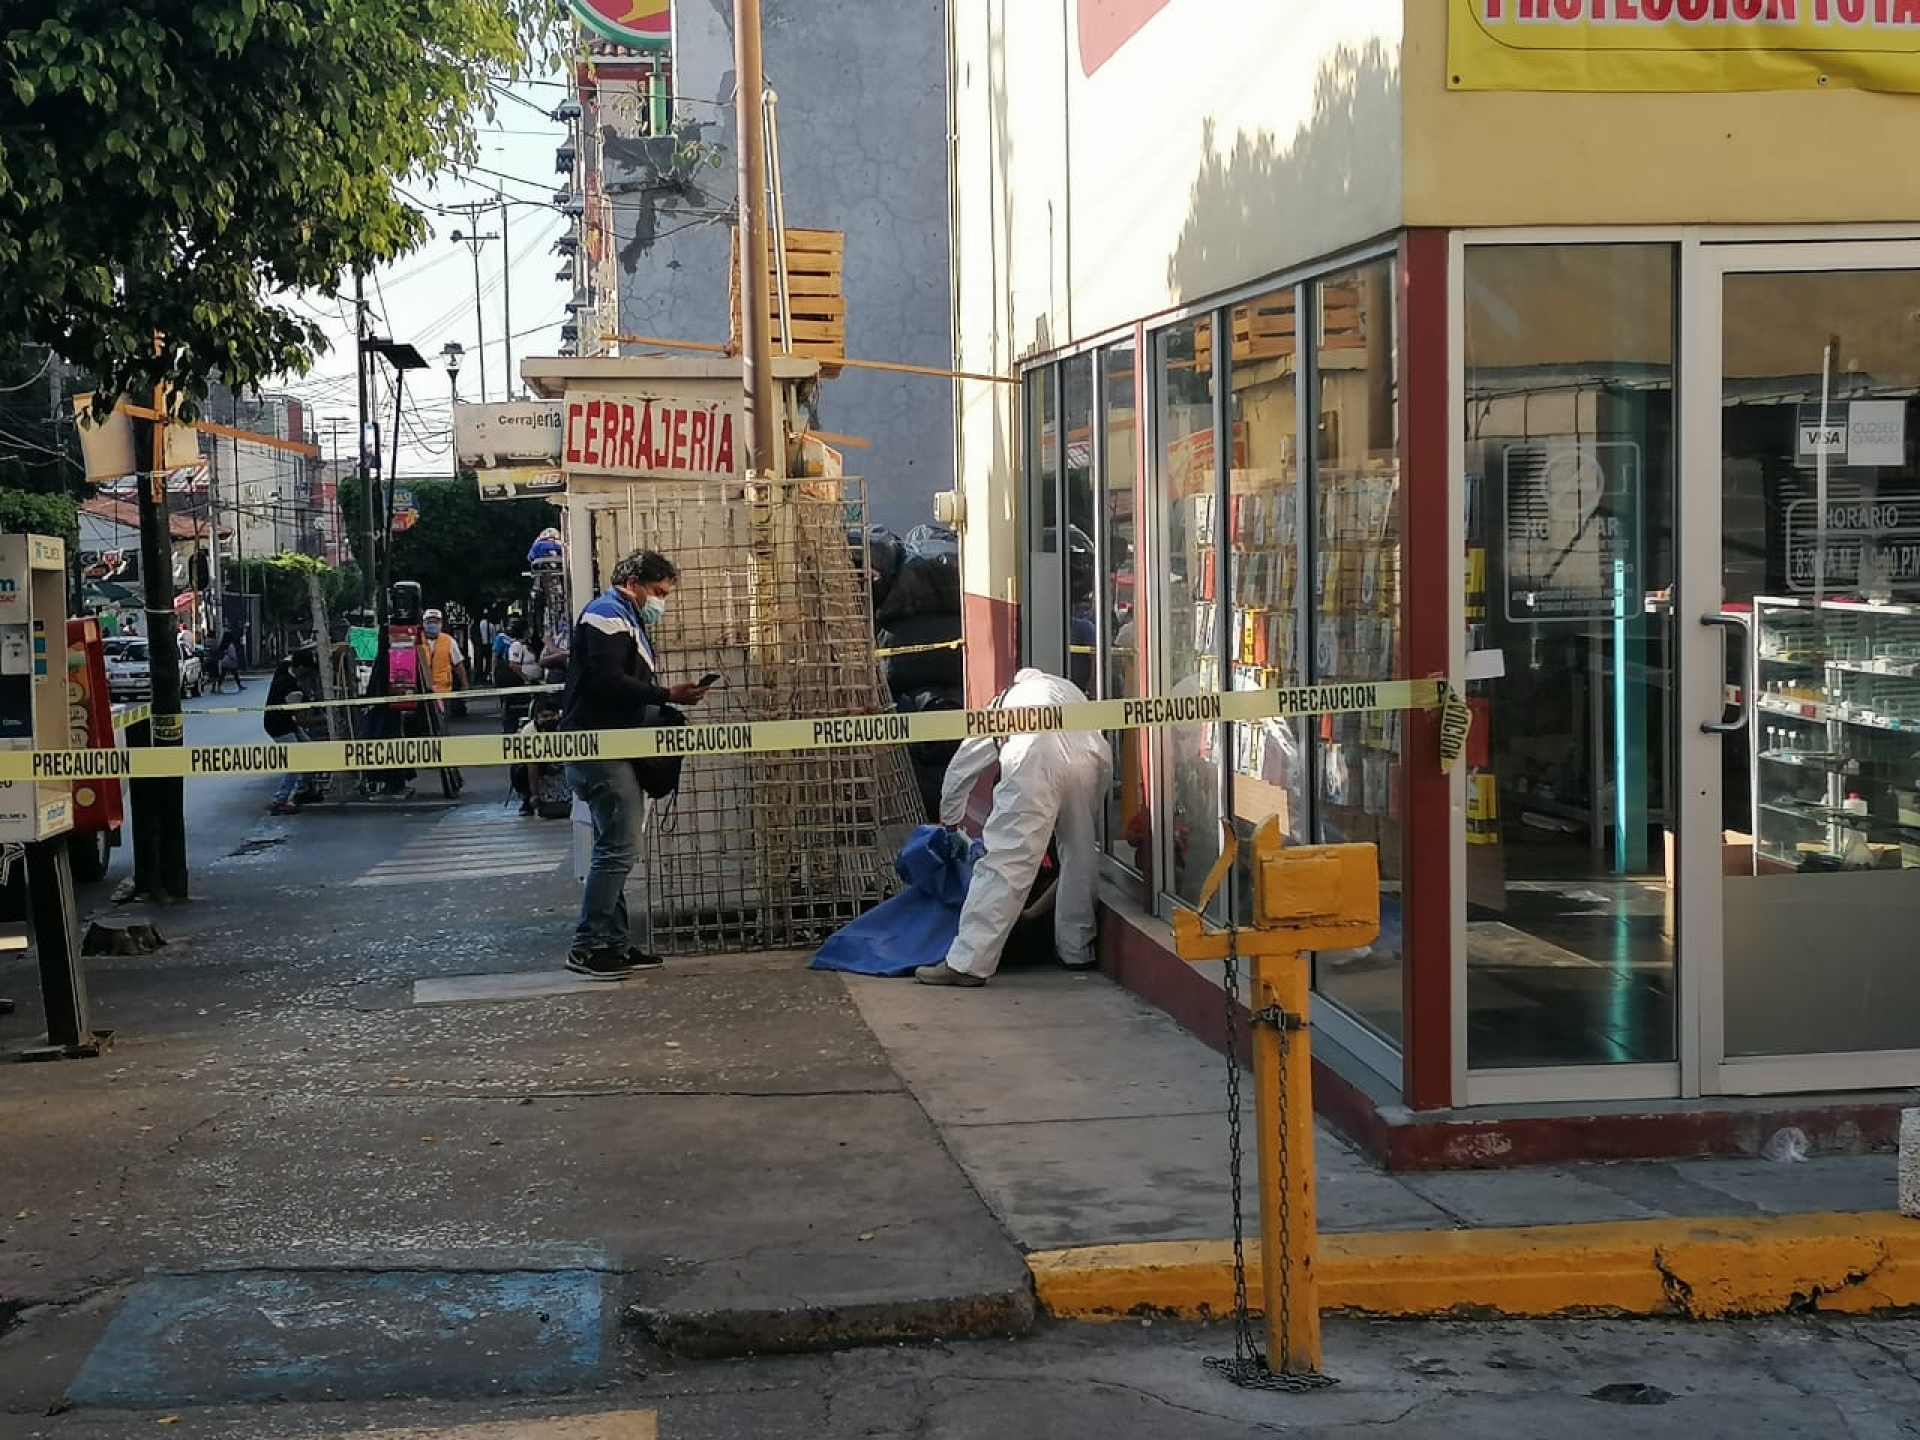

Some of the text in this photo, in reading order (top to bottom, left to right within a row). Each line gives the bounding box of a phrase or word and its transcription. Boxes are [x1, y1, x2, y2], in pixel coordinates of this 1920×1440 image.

[566, 400, 733, 473] CERRAJERÍA
[1806, 431, 1840, 444] VISA
[1124, 695, 1221, 724] PRECAUCION
[1278, 685, 1376, 713] PRECAUCION
[814, 716, 910, 744] PRECAUCION
[966, 706, 1063, 734] PRECAUCION
[345, 740, 442, 766] PRECAUCION
[503, 732, 599, 760] PRECAUCION
[655, 726, 752, 753] PRECAUCION
[33, 752, 130, 777] PRECAUCION
[191, 746, 288, 772] PRECAUCION
